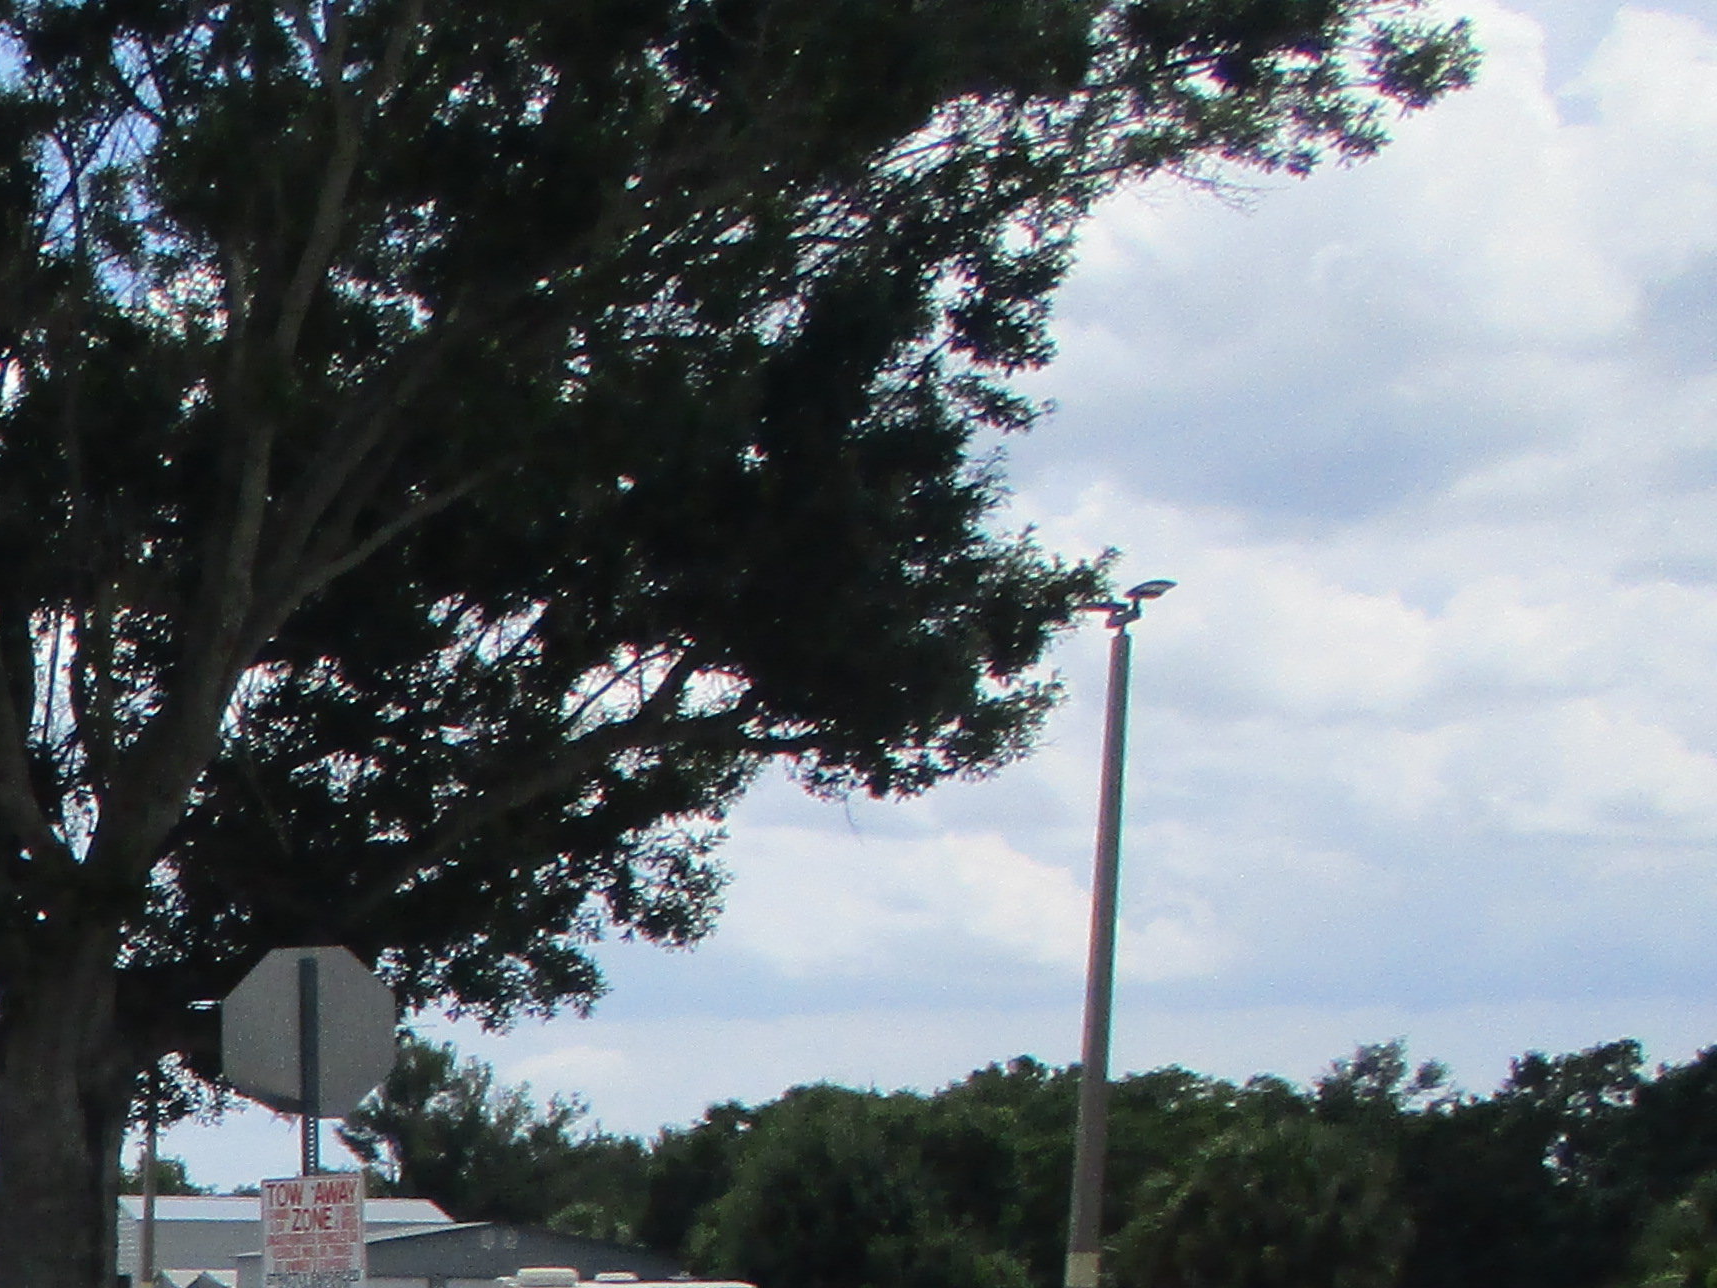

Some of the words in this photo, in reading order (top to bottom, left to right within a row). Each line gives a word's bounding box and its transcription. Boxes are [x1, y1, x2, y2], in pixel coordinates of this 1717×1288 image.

[266, 1183, 303, 1207] TOW
[314, 1181, 358, 1205] AWAY
[292, 1207, 332, 1231] ZONE
